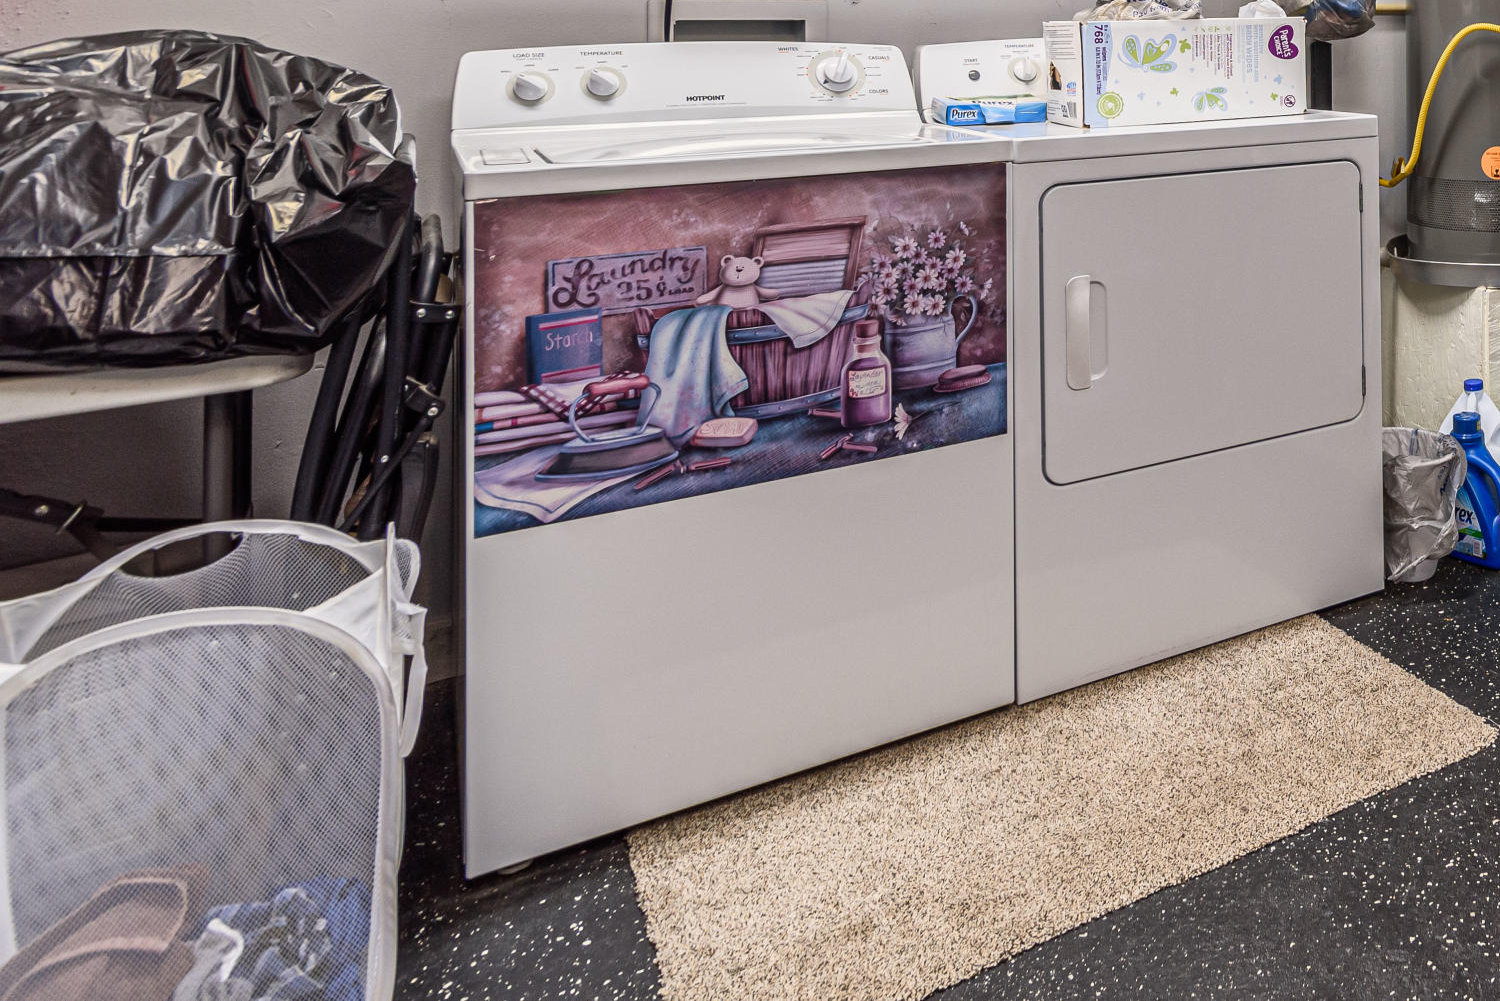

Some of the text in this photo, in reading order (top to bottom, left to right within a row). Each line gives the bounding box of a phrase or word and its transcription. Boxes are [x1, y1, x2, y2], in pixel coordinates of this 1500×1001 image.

[1094, 24, 1104, 44] 768
[951, 109, 977, 119] Purex
[552, 250, 700, 308] Laundry
[545, 327, 593, 351] Starch
[1455, 507, 1474, 524] rex
